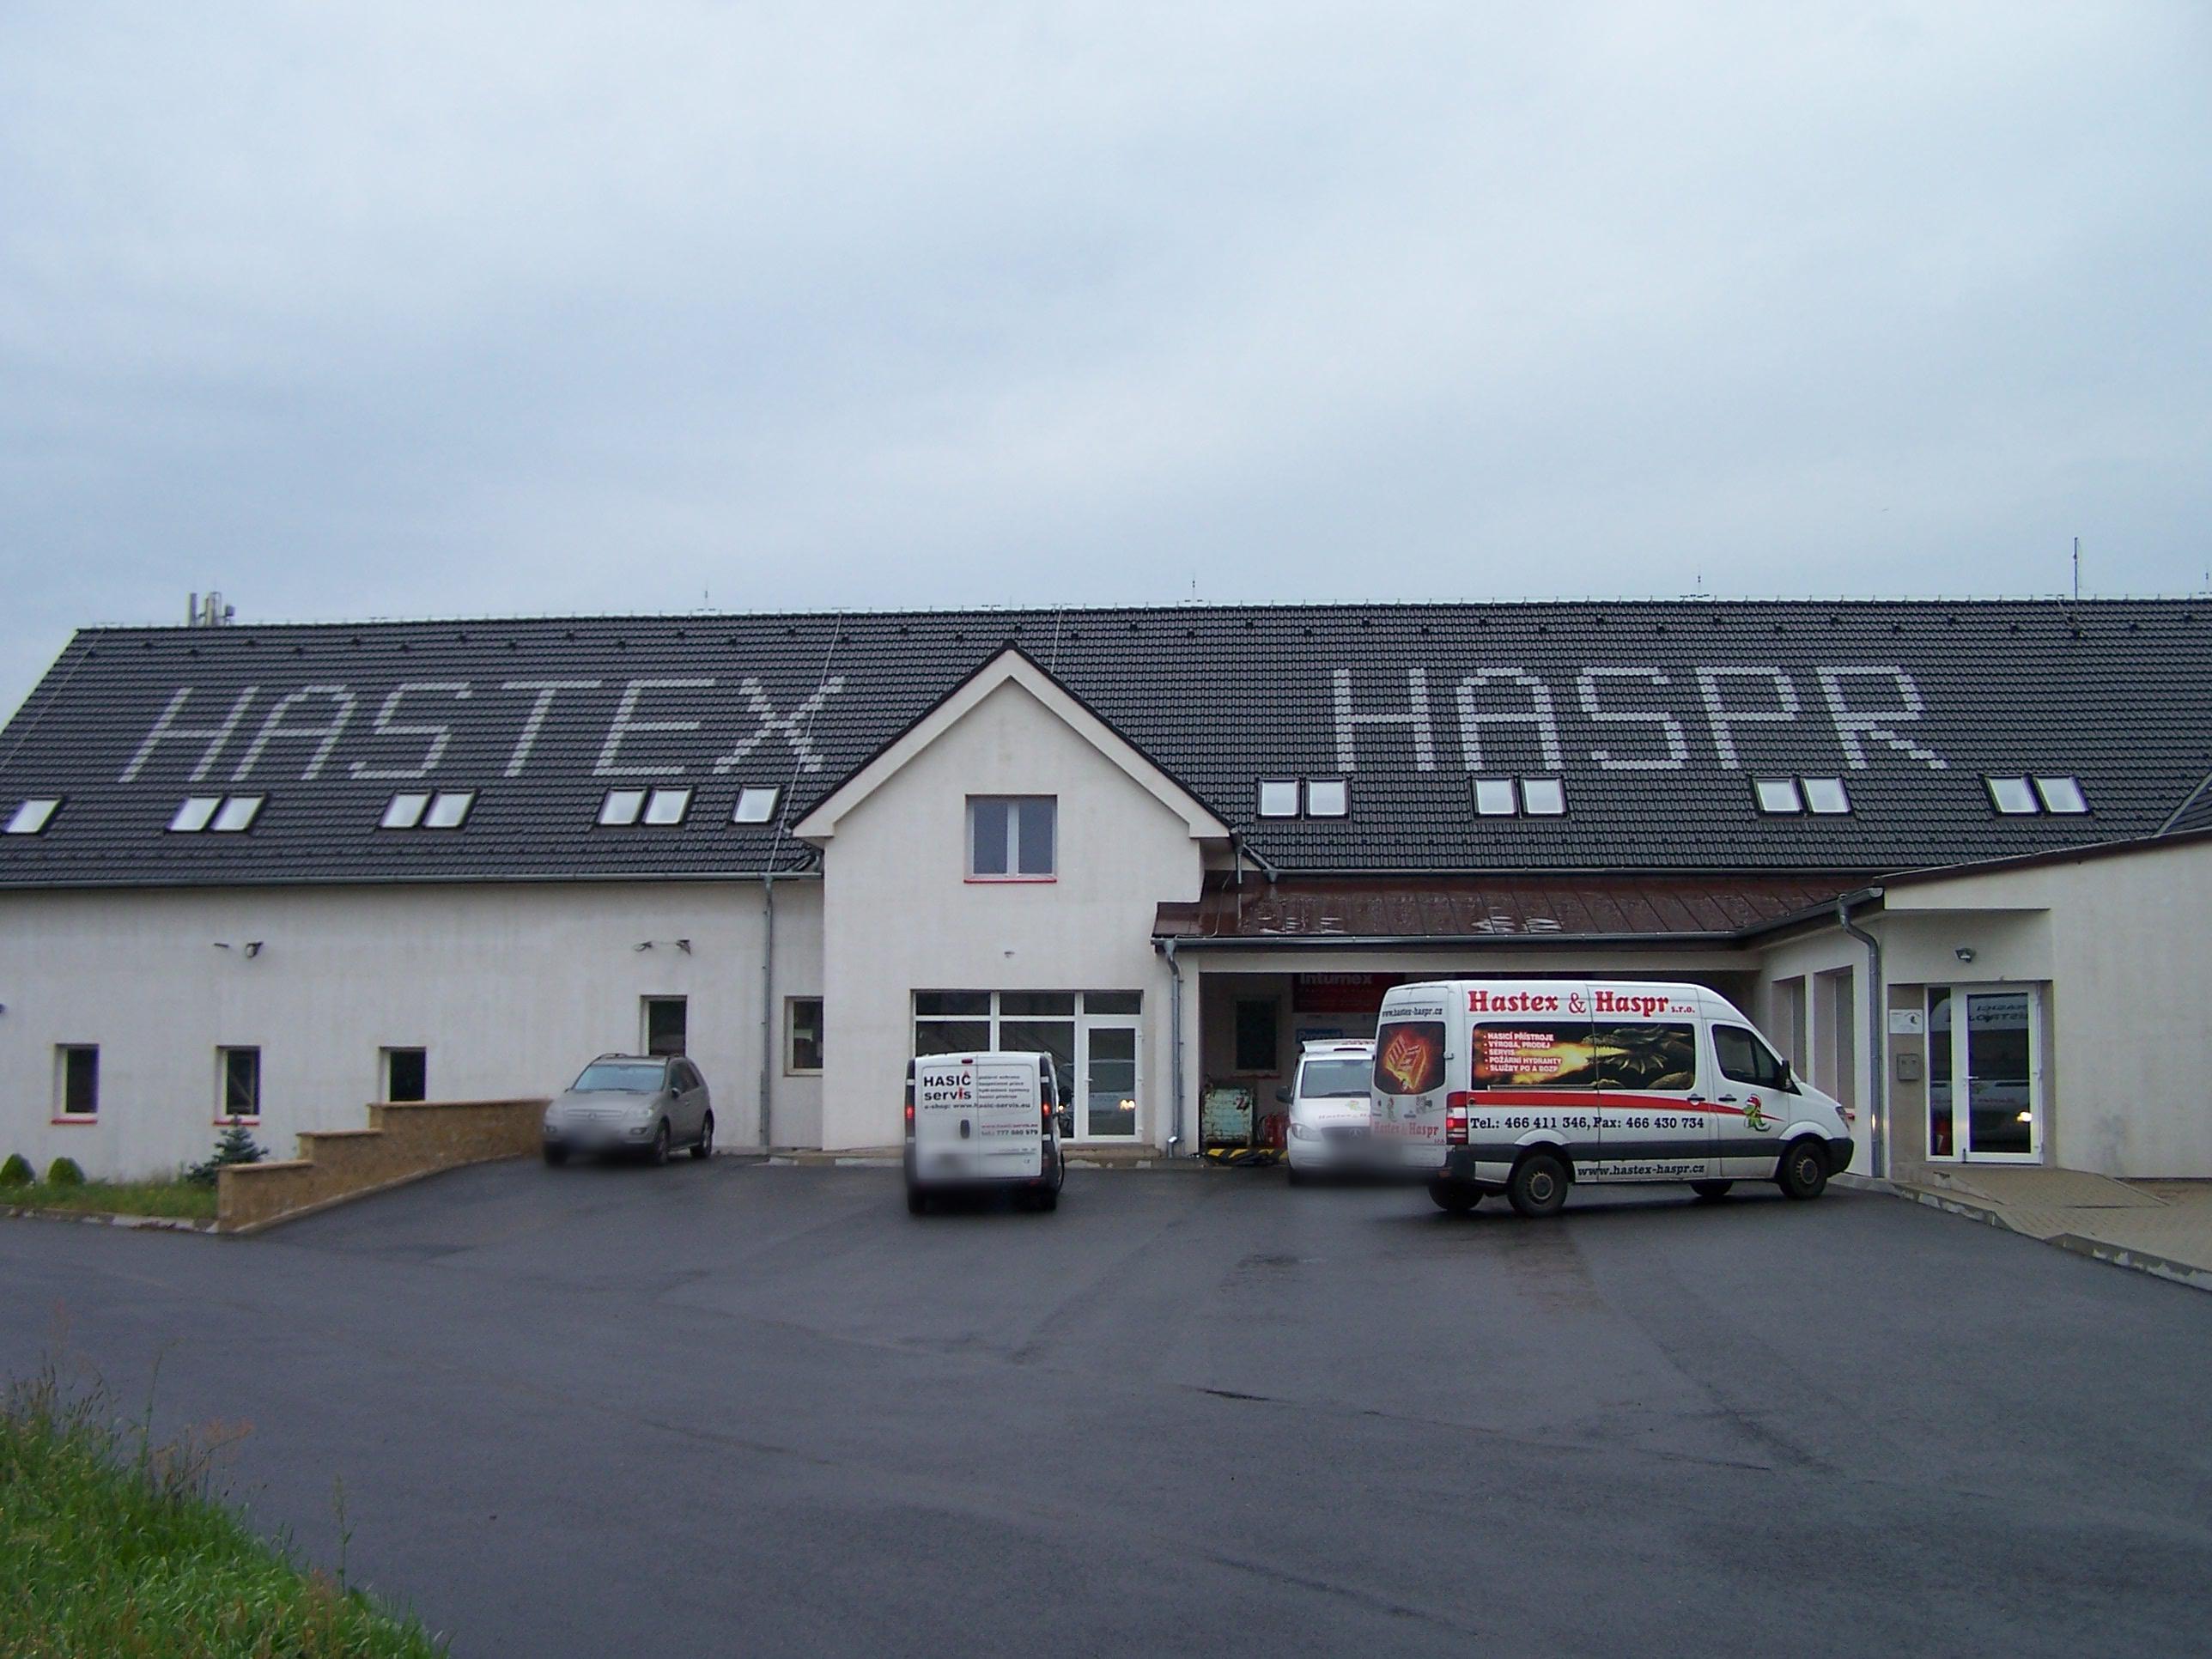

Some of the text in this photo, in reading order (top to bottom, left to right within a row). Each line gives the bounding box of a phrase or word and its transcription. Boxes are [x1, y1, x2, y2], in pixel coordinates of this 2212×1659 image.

[1333, 665, 1948, 771] HASPR
[118, 675, 847, 782] HASTEX
[1468, 990, 1696, 1017] Hastex & Haspr s.r.o.
[924, 1087, 972, 1101] servis
[1470, 1117, 1499, 1129] Tel.:
[1504, 1117, 1529, 1128] 466
[1534, 1117, 1558, 1128] 411
[1592, 1117, 1621, 1128] Fax:
[1626, 1117, 1650, 1128] 466
[1653, 1117, 1677, 1128] 430
[1681, 1117, 1705, 1128] 734
[1577, 1164, 1705, 1177] www.hastex-haspr.cz
